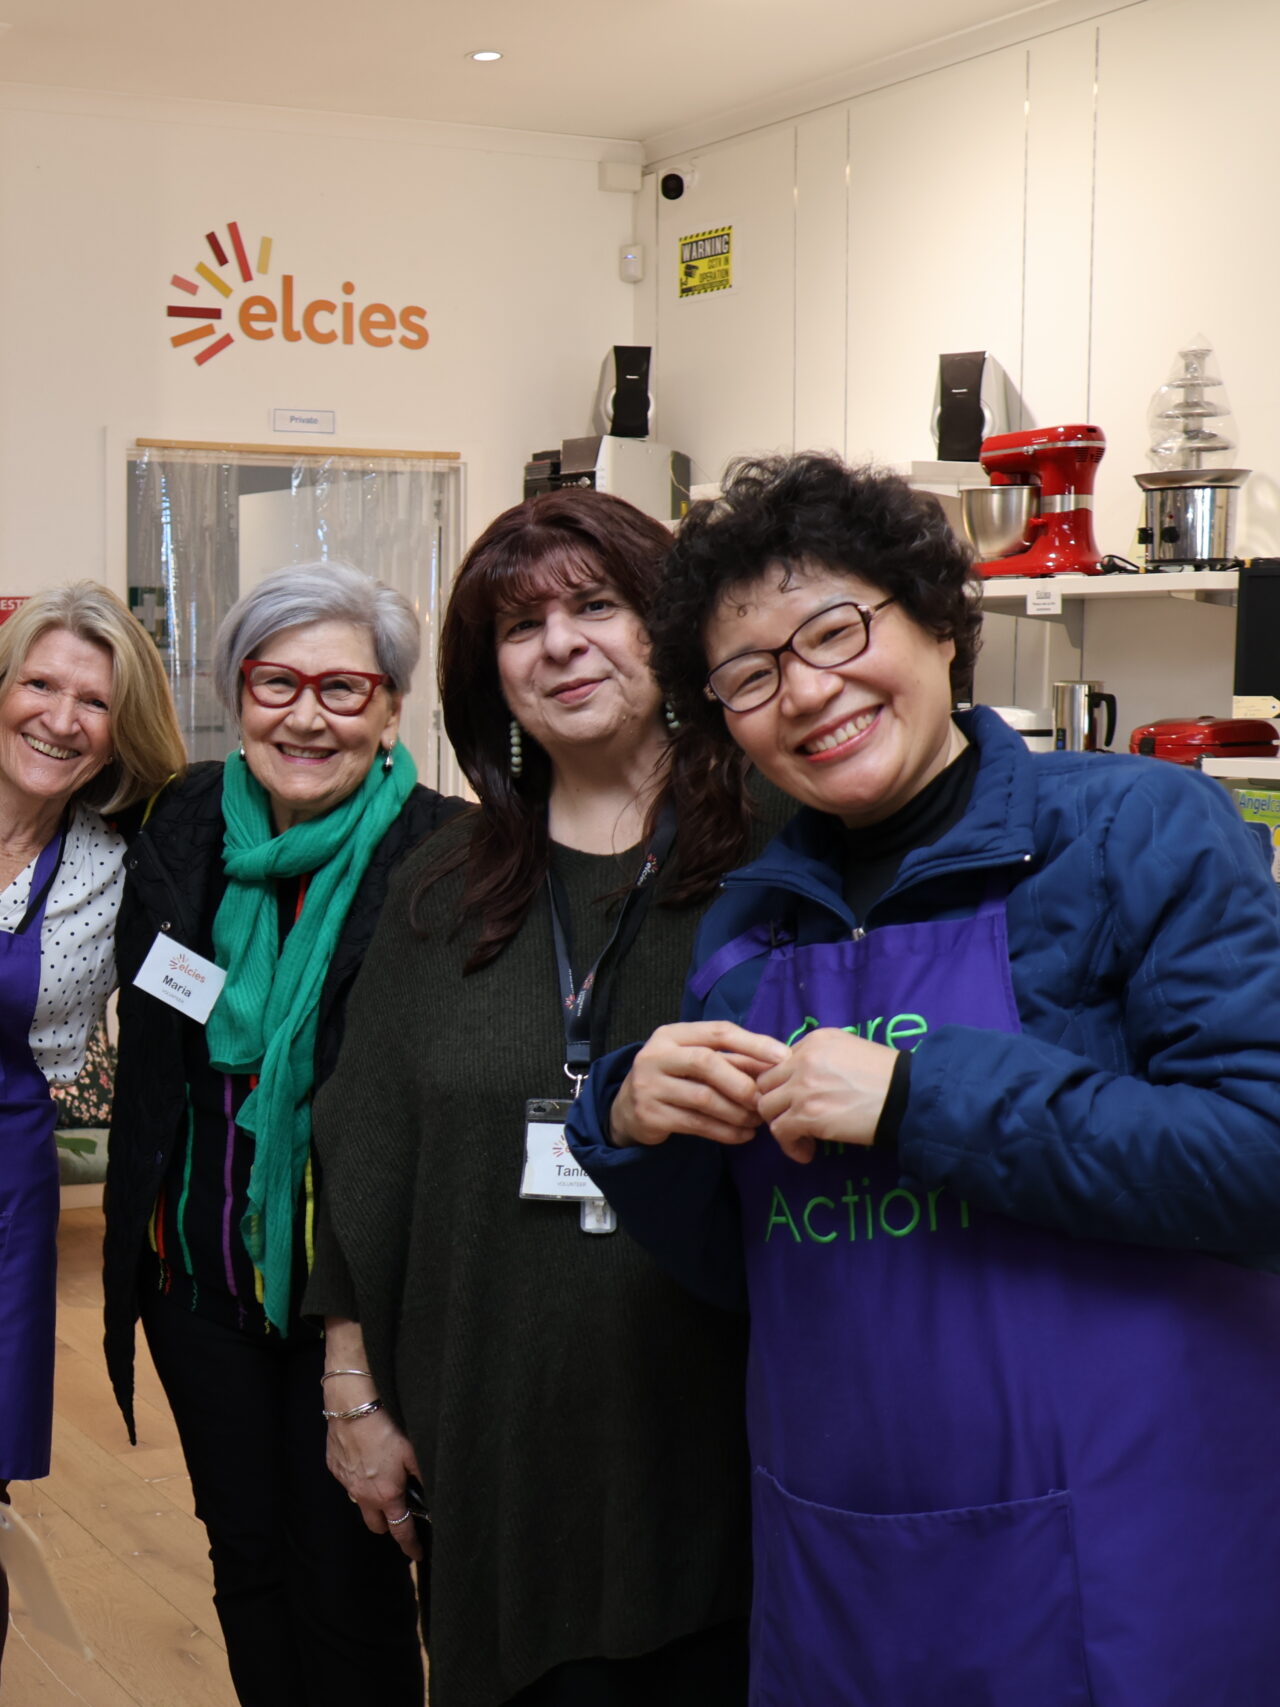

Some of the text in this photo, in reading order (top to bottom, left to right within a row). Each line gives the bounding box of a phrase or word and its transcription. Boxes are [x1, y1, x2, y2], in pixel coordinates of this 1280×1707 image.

[683, 235, 728, 262] WARNING
[238, 274, 429, 350] elcies
[289, 415, 319, 424] Private
[179, 963, 206, 984] elcies
[162, 975, 192, 998] Maria
[765, 1178, 970, 1244] Action
